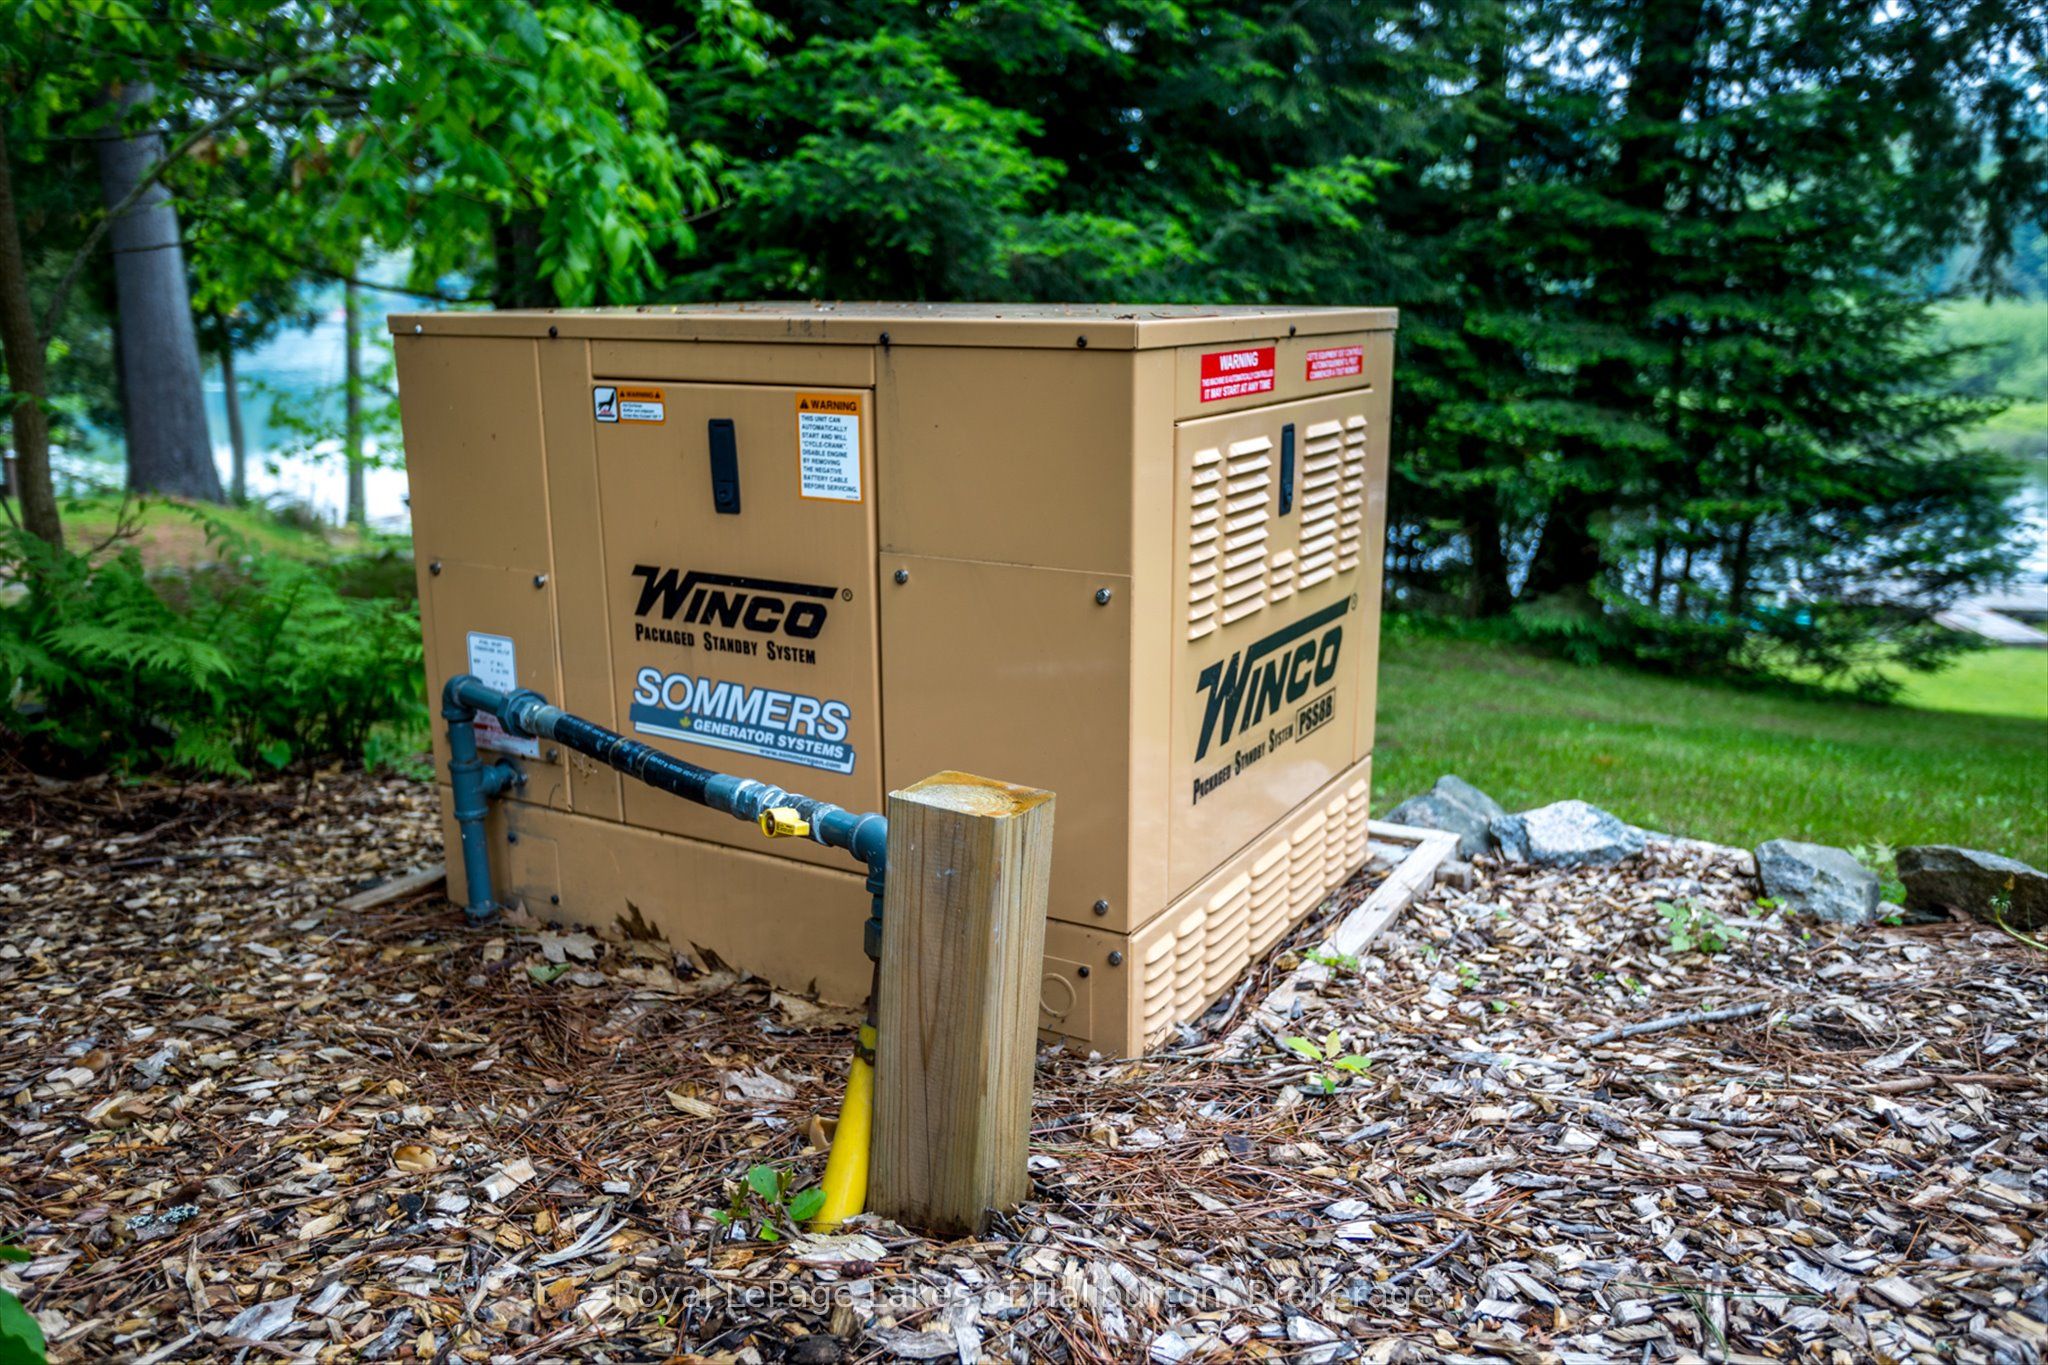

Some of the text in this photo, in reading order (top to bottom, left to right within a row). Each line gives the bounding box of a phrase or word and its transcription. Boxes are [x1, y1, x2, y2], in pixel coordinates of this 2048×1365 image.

[1219, 351, 1259, 371] WARNING
[1210, 387, 1222, 398] MAY
[1222, 384, 1240, 396] START
[1248, 380, 1259, 391] ANY
[1259, 379, 1271, 390] TIME
[810, 399, 857, 411] WARNING
[801, 423, 848, 432] AUTOMATICALLY
[802, 449, 848, 458] DISABLE ENGINE
[811, 458, 841, 466] REMOVING
[803, 474, 828, 482] BATTERY
[815, 466, 842, 475] NEGATIVE
[803, 482, 825, 490] BEFORE
[632, 564, 838, 640] WINCO
[635, 623, 816, 665] PACKAGED STANDBY SYSTEM
[1194, 595, 1351, 763] WINCO
[633, 667, 851, 743] SOMMERS
[693, 718, 844, 759] GENERATOR SYSTEMS
[1193, 765, 1231, 805] PACKAGED
[1235, 742, 1266, 775] STANDBY
[1269, 724, 1294, 753] SYSTEM
